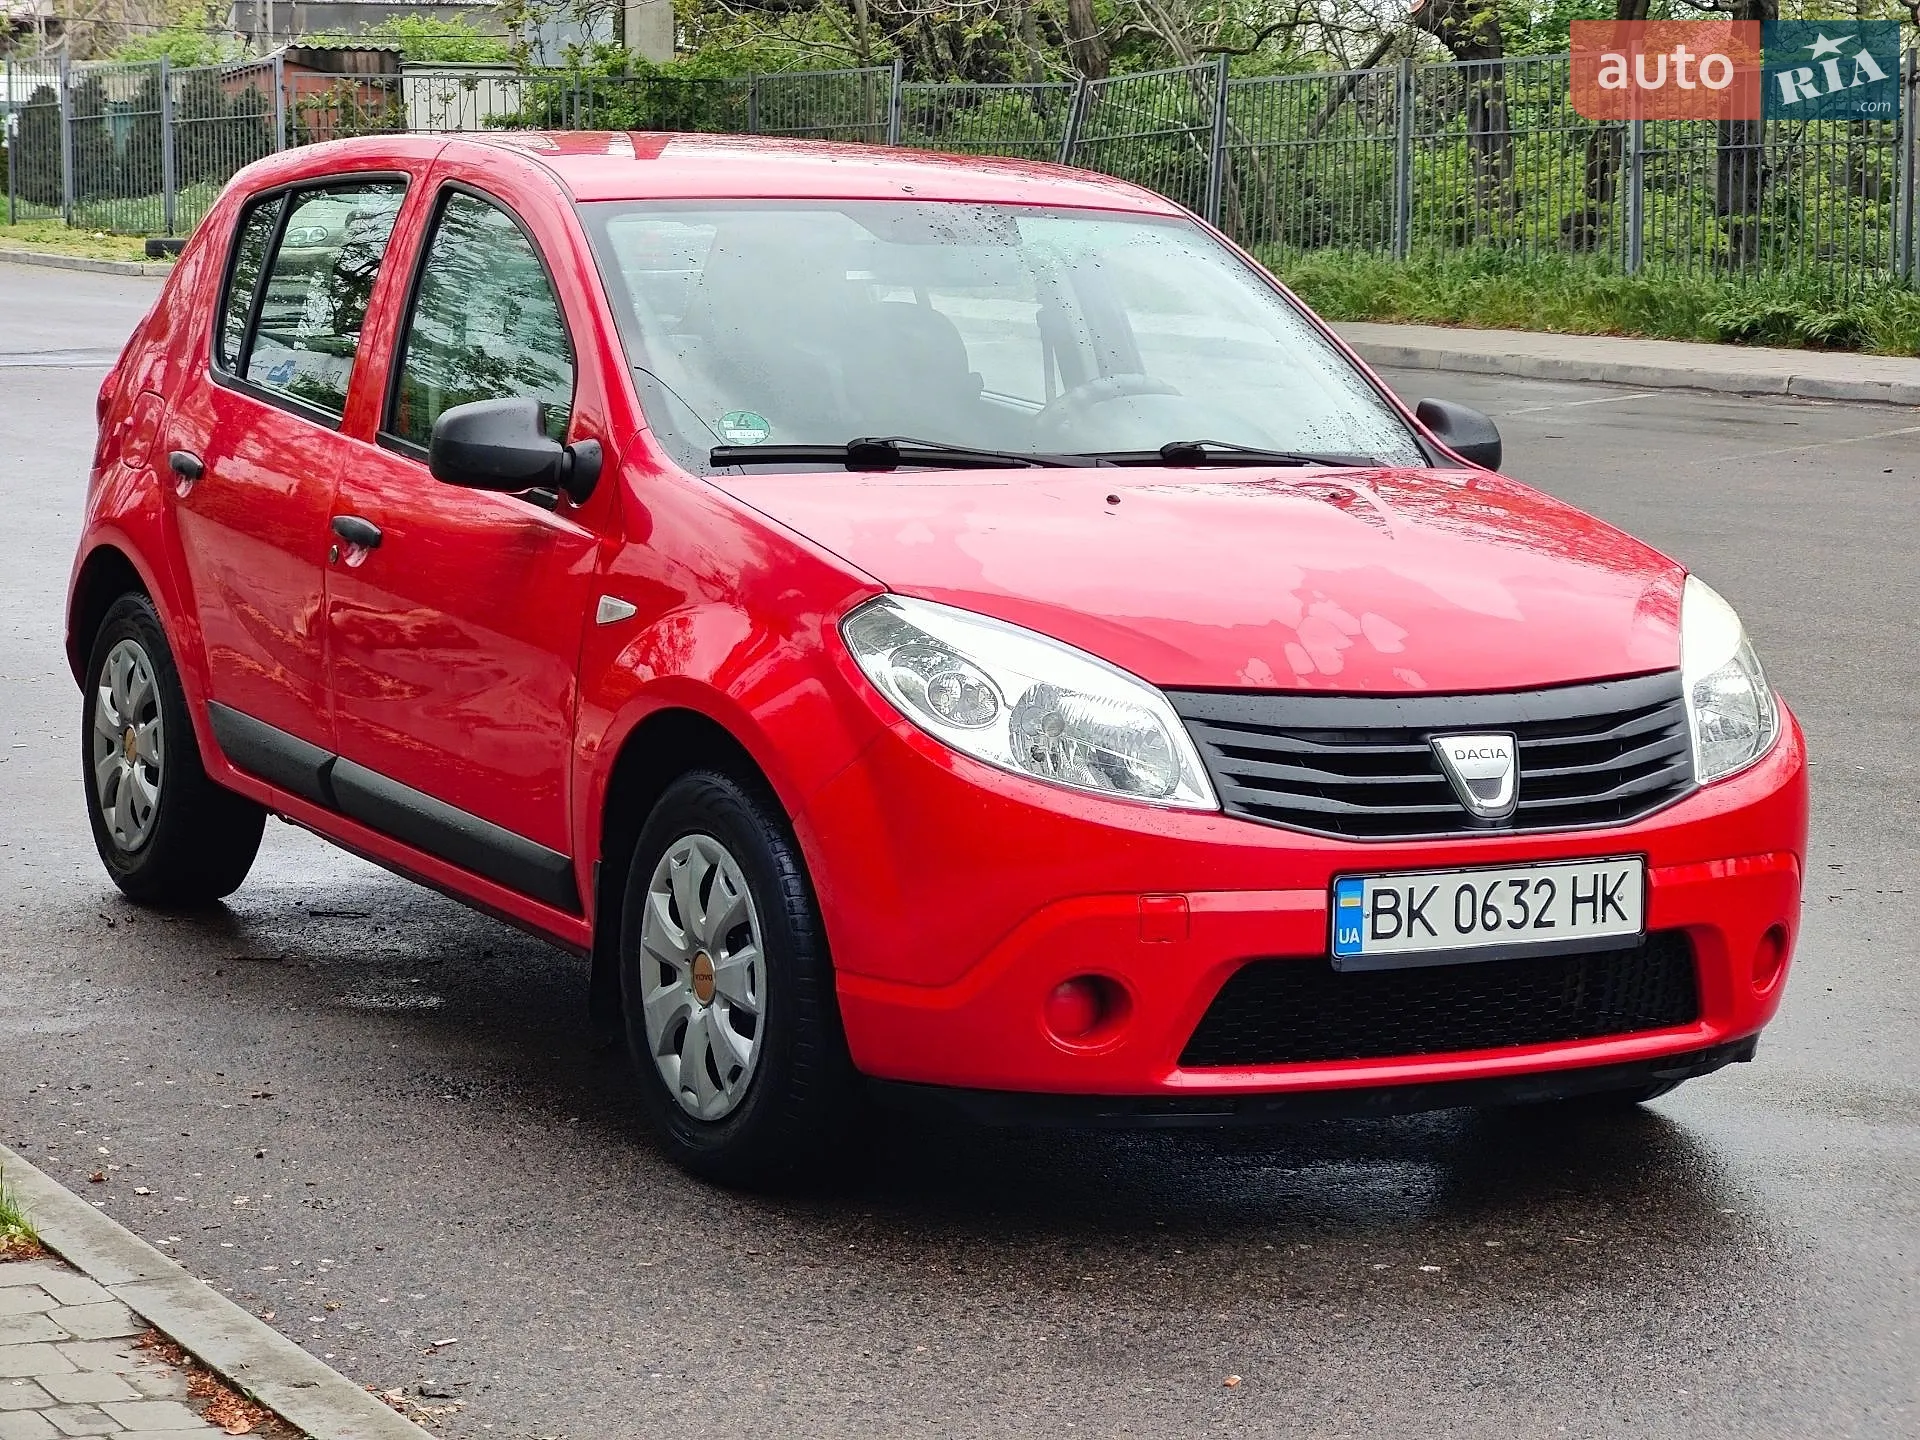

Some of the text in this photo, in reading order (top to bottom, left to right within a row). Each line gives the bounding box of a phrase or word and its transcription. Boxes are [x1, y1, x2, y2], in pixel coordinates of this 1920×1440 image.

[736, 413, 751, 428] 4
[1454, 748, 1508, 760] DACIA
[1371, 870, 1630, 940] BK 0632 HK
[1339, 927, 1360, 944] UA
